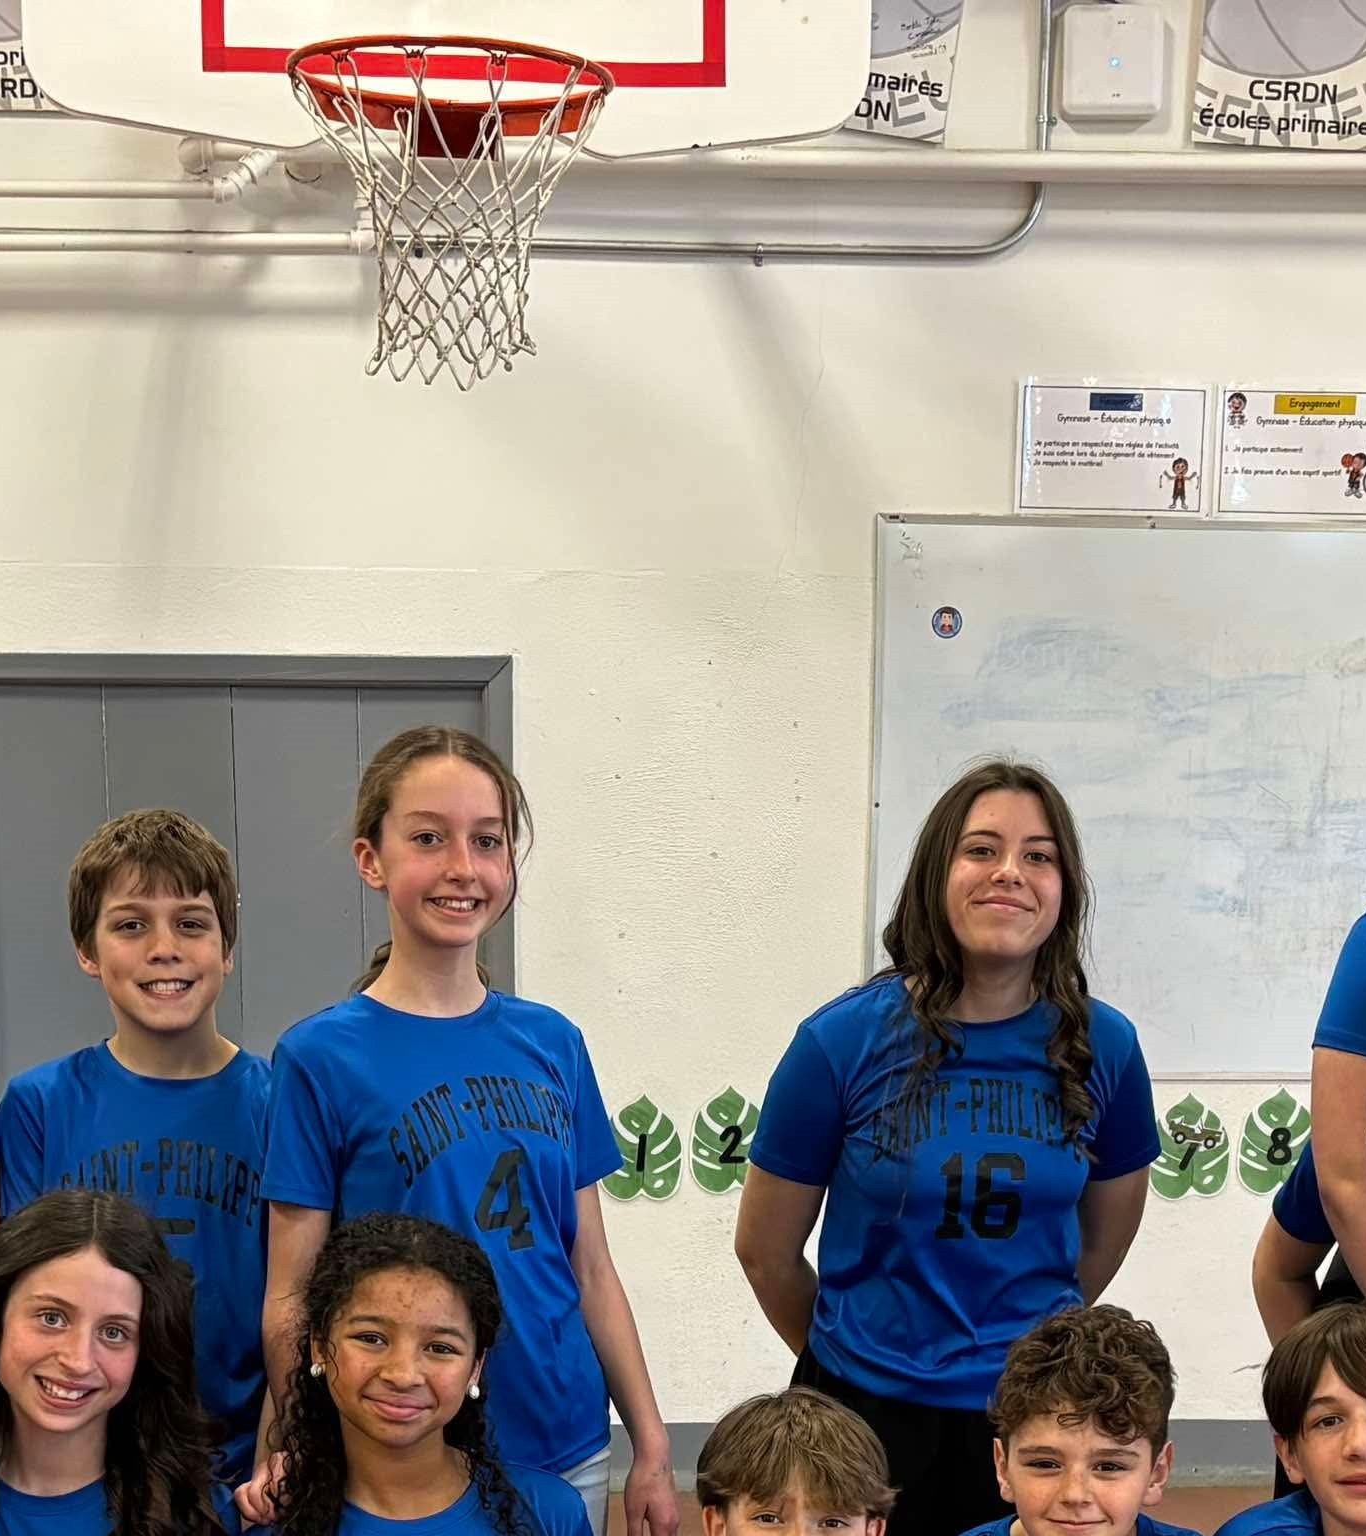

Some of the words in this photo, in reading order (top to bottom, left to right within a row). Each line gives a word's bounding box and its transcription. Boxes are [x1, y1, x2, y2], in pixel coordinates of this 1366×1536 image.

[868, 72, 943, 98] maires
[1249, 79, 1338, 105] CSRDN
[1199, 103, 1271, 130] Écoles
[1289, 398, 1341, 412] Engagement
[1057, 413, 1091, 425] Gymnase
[1101, 412, 1137, 424] Éducation
[1139, 417, 1172, 427] physiqe
[1256, 416, 1289, 428] Gymnase
[1299, 416, 1336, 426] Éducation
[636, 1133, 647, 1172] 1
[719, 1125, 747, 1164] 2
[1267, 1127, 1292, 1166] 8
[475, 1147, 536, 1252] 4
[935, 1151, 1027, 1240] 16
